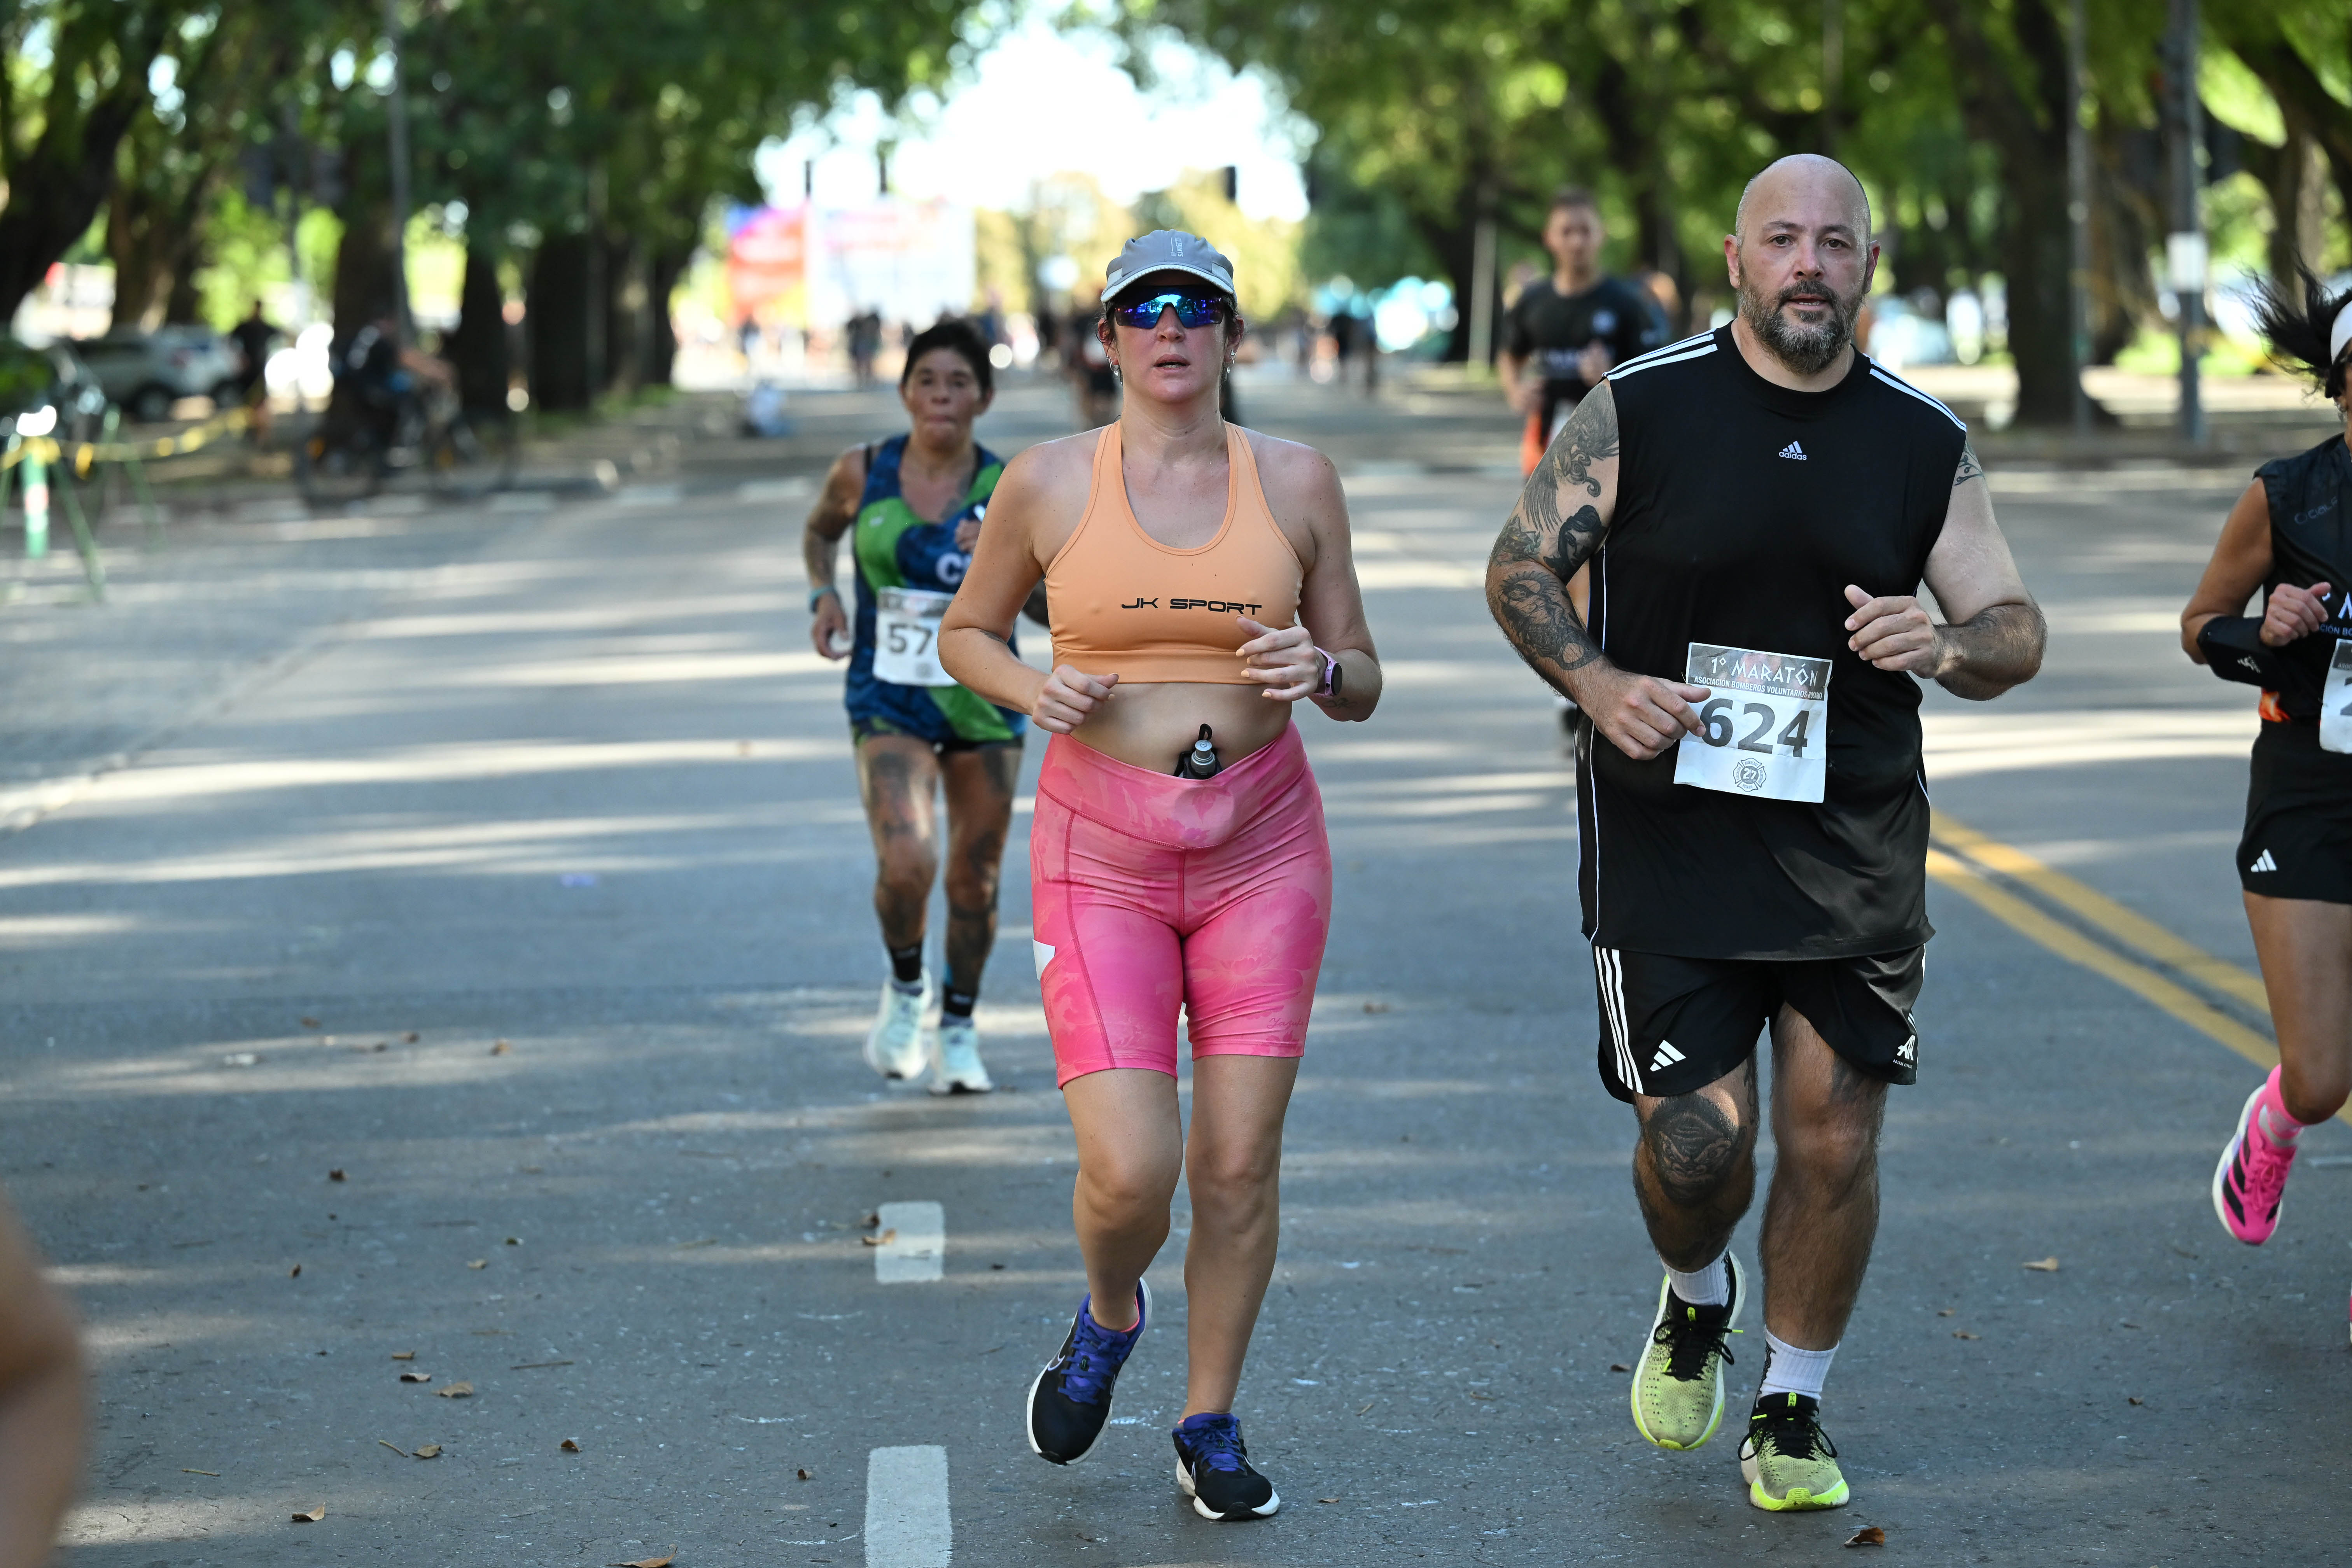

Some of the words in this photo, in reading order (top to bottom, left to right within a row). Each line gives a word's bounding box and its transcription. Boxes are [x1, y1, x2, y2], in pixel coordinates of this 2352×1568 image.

[1779, 452, 1807, 460] adidas
[1121, 598, 1159, 609] JK
[1170, 598, 1262, 615] SPORT
[1731, 659, 1818, 687] MARATÓN
[1694, 676, 1730, 687] ASOCIACIÓN
[1731, 681, 1765, 692] BOMBEROS
[1767, 685, 1807, 698] VOLUNTARIOS
[1700, 698, 1810, 758] 624
